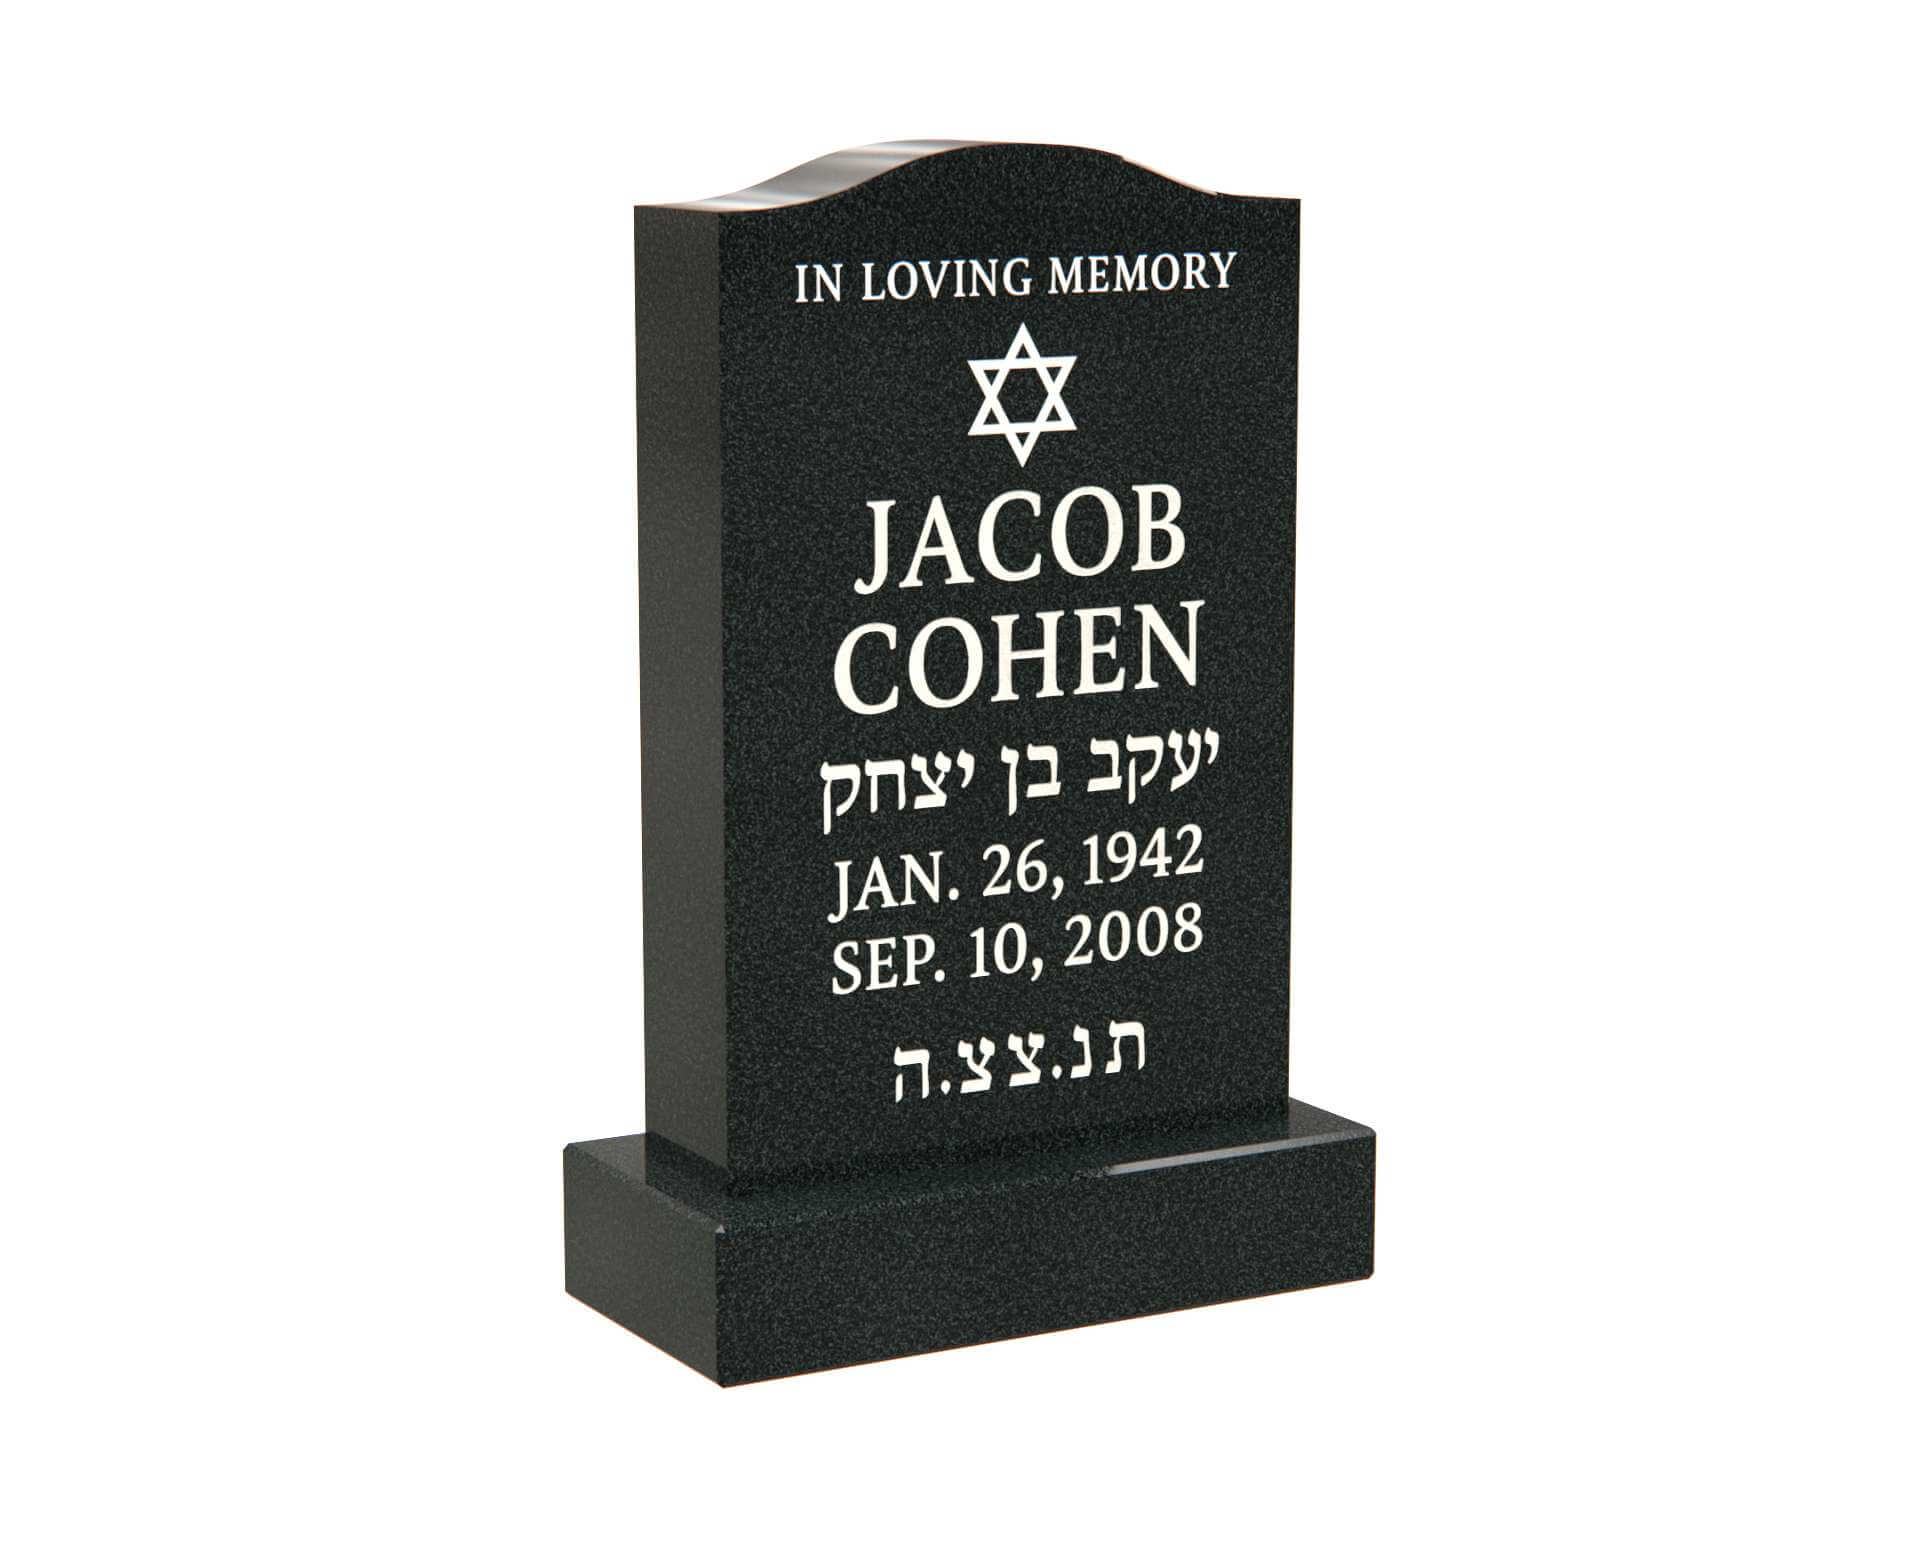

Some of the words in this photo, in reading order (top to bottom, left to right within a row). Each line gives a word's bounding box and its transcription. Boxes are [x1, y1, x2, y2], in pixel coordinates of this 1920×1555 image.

[795, 264, 844, 303] IN
[861, 257, 1033, 301] LOVING
[1047, 251, 1238, 295] MEMORY
[853, 483, 1186, 595] JACOB
[832, 599, 1206, 716] COHEN
[820, 748, 976, 835] יצחק
[1000, 743, 1062, 817] בן
[1086, 726, 1221, 805] יעקב
[827, 850, 960, 924] JAN.
[982, 838, 1065, 901] 26,
[1082, 823, 1205, 886] 1942
[831, 933, 946, 996] SEP.
[969, 922, 1044, 982] 10,
[1063, 901, 1204, 967] 2008
